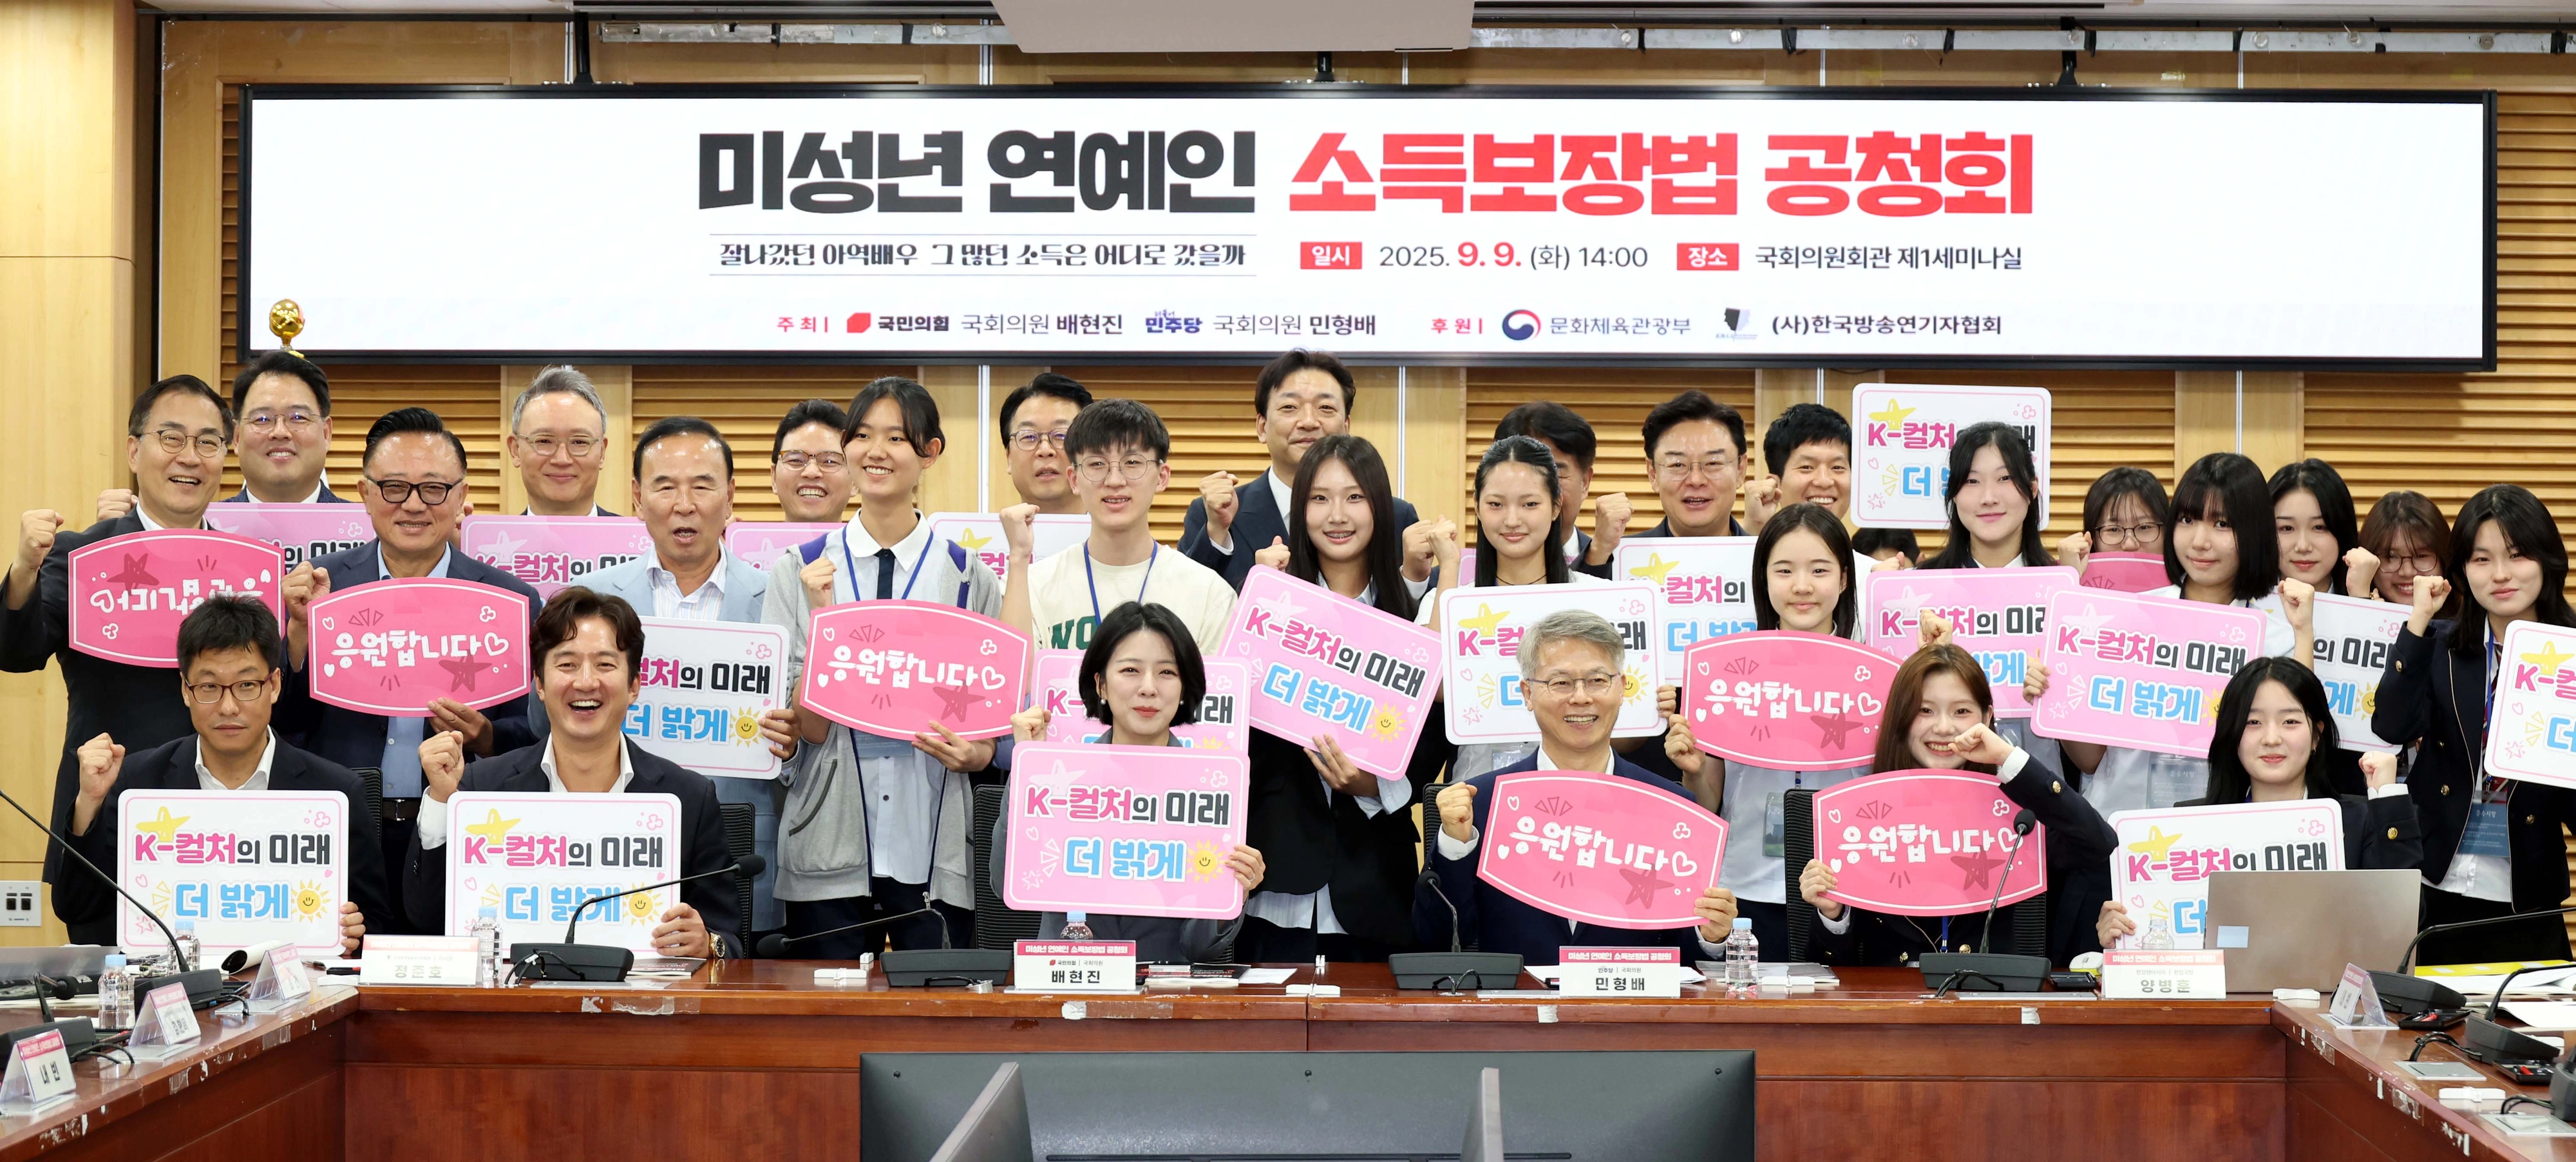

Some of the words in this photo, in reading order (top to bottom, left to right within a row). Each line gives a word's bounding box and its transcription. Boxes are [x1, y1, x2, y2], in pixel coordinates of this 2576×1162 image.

[699, 130, 963, 214] 미성년
[987, 130, 1256, 213] 연예인
[1289, 131, 1739, 215] 소득보장법
[1765, 130, 2032, 216] 공청회
[720, 243, 815, 265] 잘나갔던
[823, 243, 918, 265] 아역배우
[931, 244, 954, 265] 그
[961, 243, 1008, 265] 많던
[1016, 243, 1087, 265] 소득은
[1095, 243, 1166, 265] 어디로
[1174, 243, 1246, 266] 갔을까
[1311, 245, 1350, 266] 일시
[1379, 245, 1451, 267] 2025.
[1457, 242, 1486, 267] 9.
[1493, 242, 1522, 267] 9.
[1530, 244, 1570, 270] (화)
[1578, 246, 1649, 267] 14:00
[1688, 245, 1728, 266] 장소
[1755, 245, 1891, 270] 국회의원회관
[1897, 245, 2023, 270] 제1세미나실
[878, 315, 950, 332] 국민의힘
[961, 314, 1048, 334] 국회의원
[1057, 314, 1122, 335] 배현진
[1146, 317, 1203, 334] 민주당
[1213, 314, 1301, 335] 국회의원
[1309, 314, 1376, 336] 민형배
[1549, 314, 1691, 336] 문화체육관광부
[1772, 315, 2002, 335] (사)한국방송연기자협회
[1868, 423, 1963, 450] K-컬처
[1903, 466, 1930, 497] 더
[1667, 621, 1698, 652] 더
[1882, 607, 1998, 635] K-처의
[333, 631, 482, 668] 응원합니다
[1245, 607, 1361, 674] K-컬처의
[1364, 652, 1426, 698] 미래
[2058, 626, 2179, 668] K-컬처의
[2186, 642, 2246, 676] 미래
[711, 663, 772, 694] 미래
[827, 645, 980, 689] 응원합니다
[1264, 664, 1300, 704] 더
[1303, 679, 1372, 731] 밝게
[1704, 678, 1855, 719] 응원합니다
[2090, 678, 2124, 712] 더
[2133, 682, 2201, 722] 밝게
[621, 704, 651, 737] 더
[661, 706, 728, 742] 밝게
[1027, 785, 1157, 822] K-컬처의
[1166, 792, 1229, 826] 미래
[135, 833, 260, 864] K-컬처의
[269, 834, 330, 864] 미래
[464, 835, 591, 867] K-컬처의
[601, 837, 663, 868] 미래
[1508, 815, 1669, 870] 응원합니다
[1837, 824, 1996, 864] 응원합니다
[2265, 842, 2327, 870] 미래
[1065, 839, 1101, 877] 더
[1113, 841, 1184, 880] 밝게
[176, 884, 208, 918] 더
[220, 884, 289, 919] 밝게
[506, 887, 537, 921] 더
[551, 886, 621, 922] 밝게
[2174, 899, 2206, 934] 더
[1025, 945, 1046, 953] 미성년
[1048, 945, 1069, 953] 연예인
[1071, 946, 1105, 954] 소득보장법
[1107, 946, 1128, 954] 공청회
[1568, 952, 1589, 960] 미성년
[1591, 952, 1612, 960] 연예인
[395, 965, 442, 978] 정준호
[1052, 970, 1100, 984] 배현진
[1596, 977, 1645, 991] 민형배
[2141, 980, 2190, 993] 양병훈
